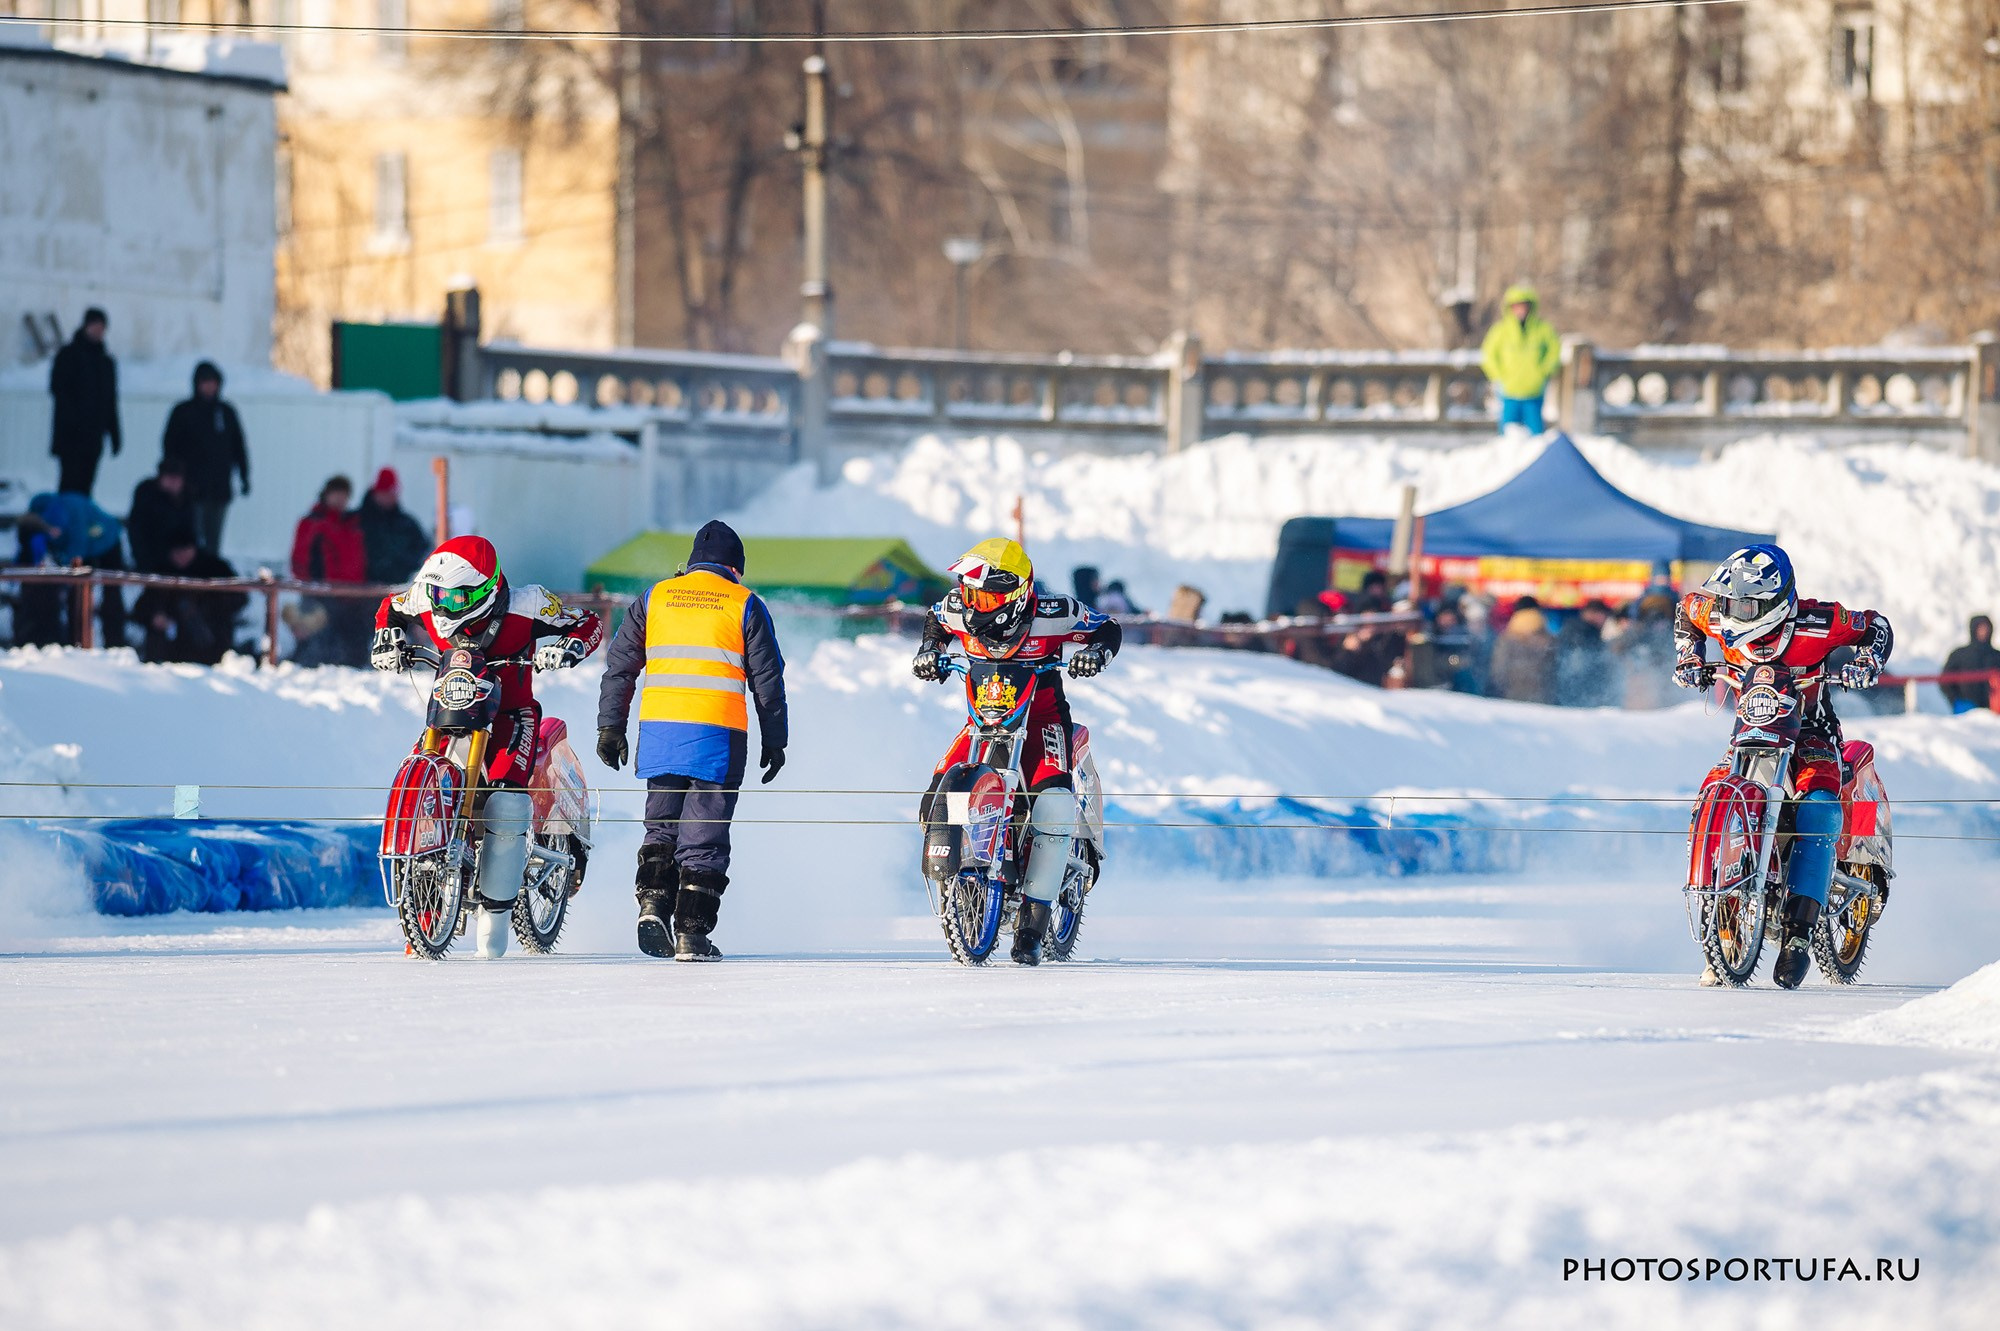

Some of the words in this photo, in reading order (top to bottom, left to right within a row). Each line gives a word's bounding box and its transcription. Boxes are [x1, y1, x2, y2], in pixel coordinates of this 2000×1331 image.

[666, 589, 730, 598] МОТОФЕДЕРАЦИЯ
[673, 595, 720, 603] РЕСПУБЛИКИ
[666, 602, 724, 610] БАШКОРТОСТАН
[446, 681, 476, 692] ТОРПЕДО
[452, 690, 474, 701] ШААЗ
[1748, 697, 1778, 708] ТОРПЕДО
[1754, 706, 1776, 716] ШААЗ
[518, 717, 535, 757] GERMAN
[514, 754, 527, 771] JB
[926, 845, 951, 857] 106
